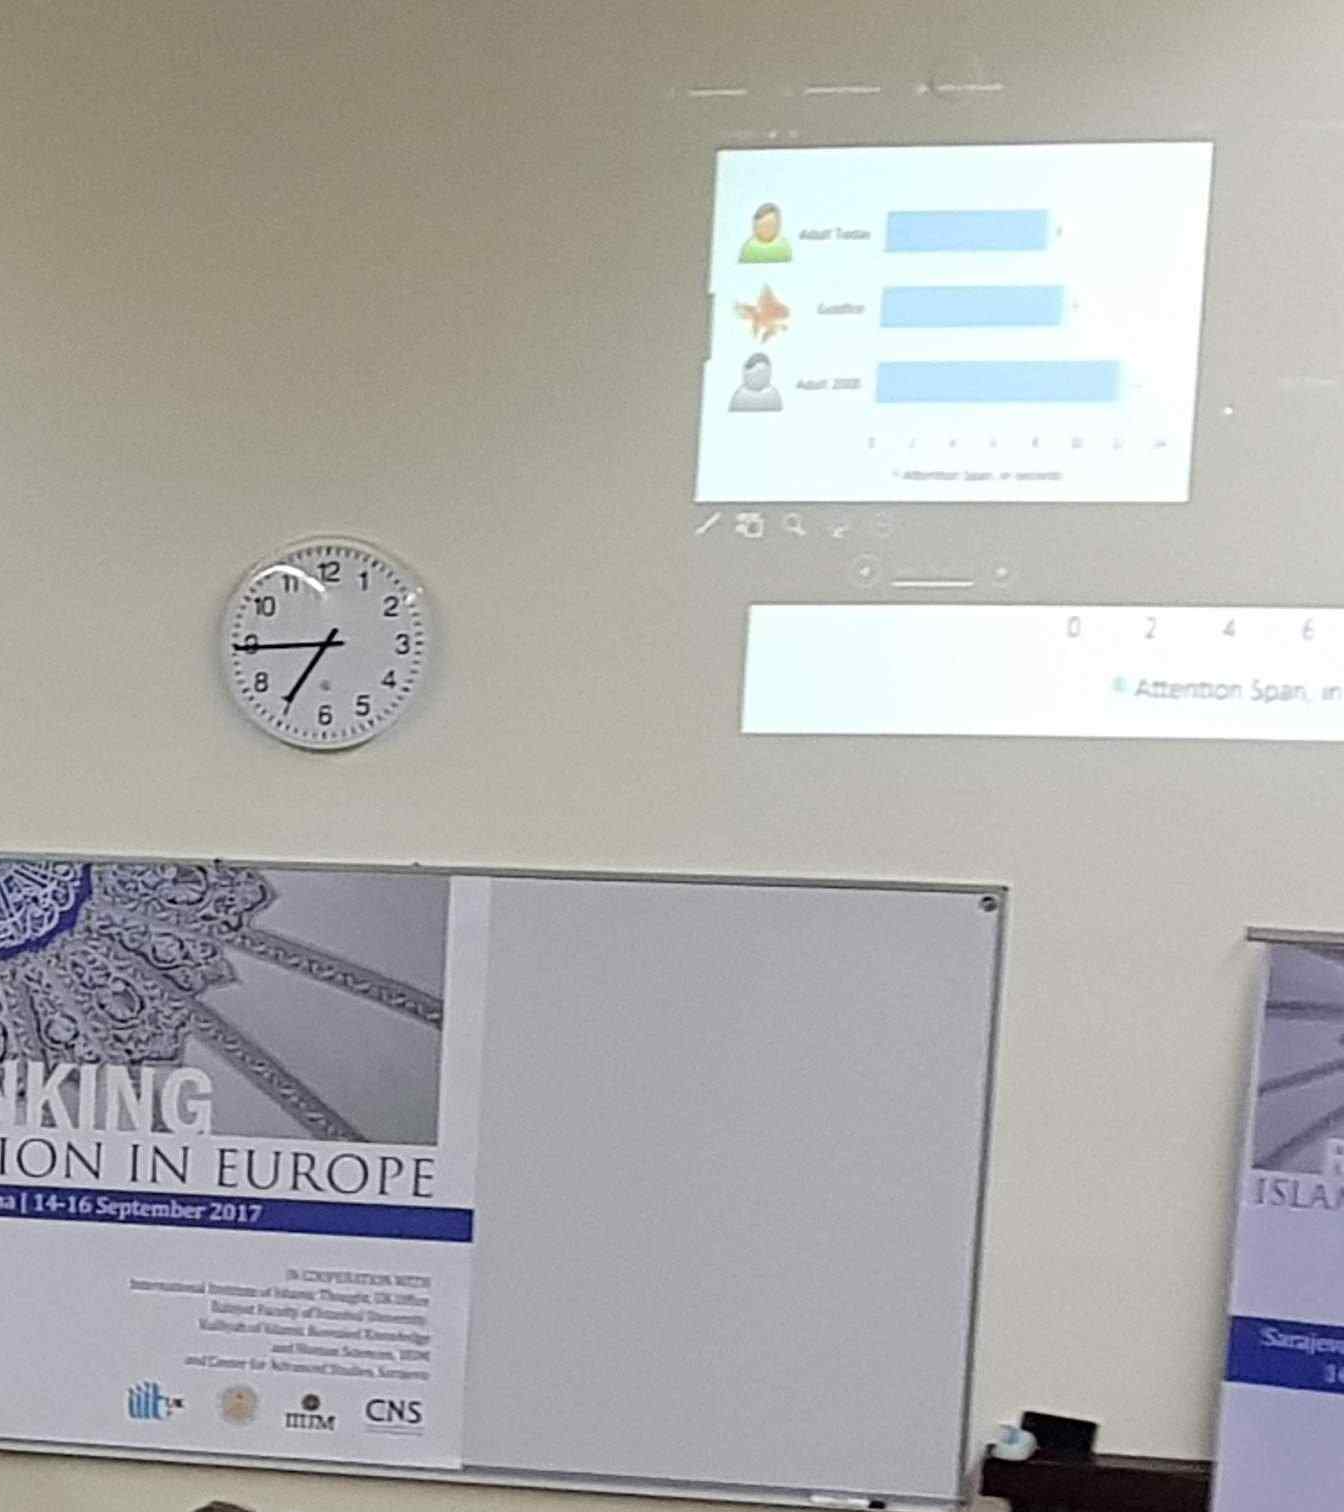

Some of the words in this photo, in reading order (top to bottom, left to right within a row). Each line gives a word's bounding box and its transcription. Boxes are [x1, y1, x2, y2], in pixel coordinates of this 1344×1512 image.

[318, 561, 341, 582] 12
[359, 571, 368, 591] 1
[282, 574, 299, 593] 11
[255, 595, 276, 617] 10
[383, 595, 400, 617] 2
[395, 633, 411, 655] 3
[254, 671, 269, 693] 8
[381, 669, 396, 689] 4
[1134, 678, 1243, 699] Attention
[318, 704, 333, 726] 6
[355, 694, 371, 717] 5
[130, 1144, 190, 1186] IN
[216, 1148, 435, 1199] EUROPE
[33, 1193, 93, 1214] 14-16
[96, 1196, 204, 1220] September
[210, 1202, 264, 1223] 2017
[365, 1397, 423, 1424] CNS
